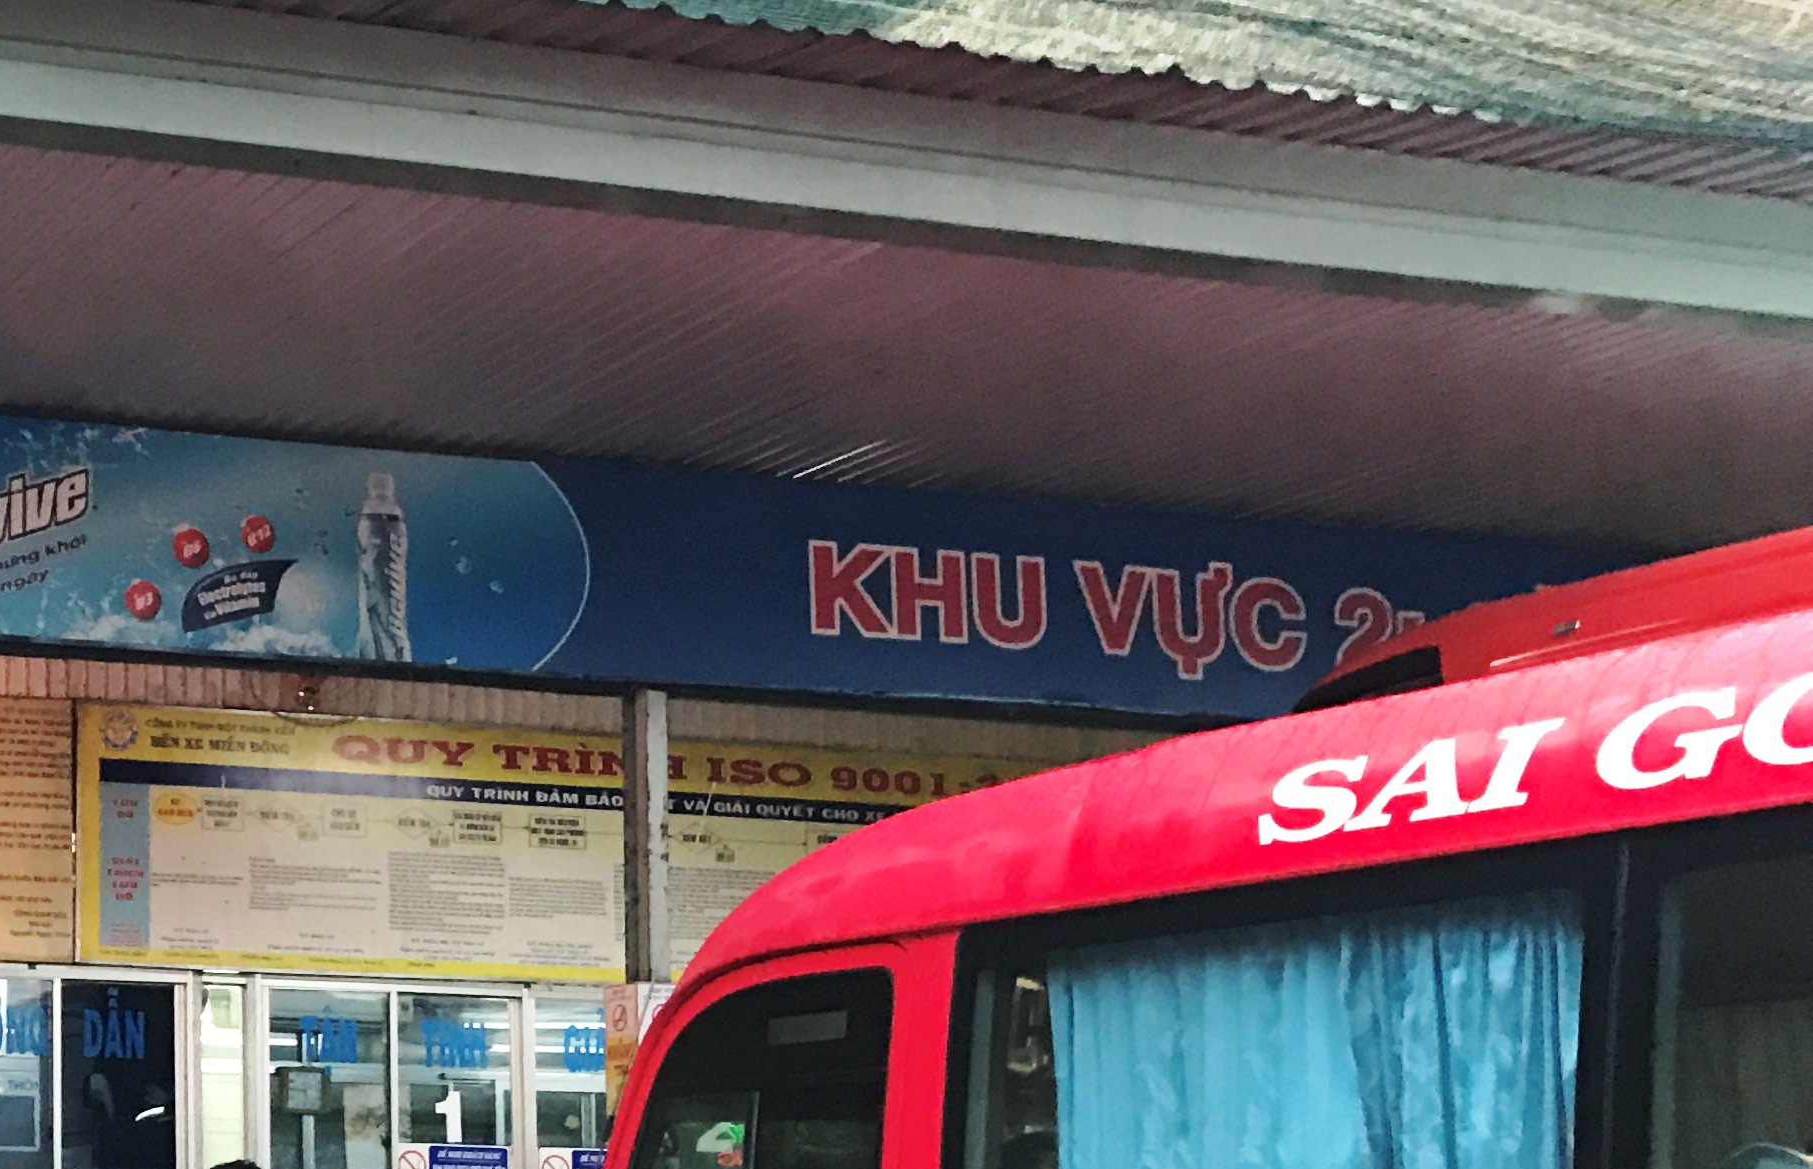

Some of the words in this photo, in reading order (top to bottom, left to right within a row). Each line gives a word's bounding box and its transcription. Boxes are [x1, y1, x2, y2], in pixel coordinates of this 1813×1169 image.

[808, 539, 1047, 650] KHU
[1073, 560, 1308, 681] VỰC
[184, 738, 204, 750] XE
[331, 733, 475, 768] QUY
[706, 756, 813, 788] ISO
[426, 783, 466, 802] QUY
[471, 785, 530, 803] TRÌNH
[535, 788, 580, 805] ĐẢM
[585, 790, 624, 807] BẢO
[822, 806, 859, 823] CHO
[1258, 716, 1566, 846] SAI
[83, 986, 145, 1060] DẪN
[434, 1090, 463, 1143] 1
